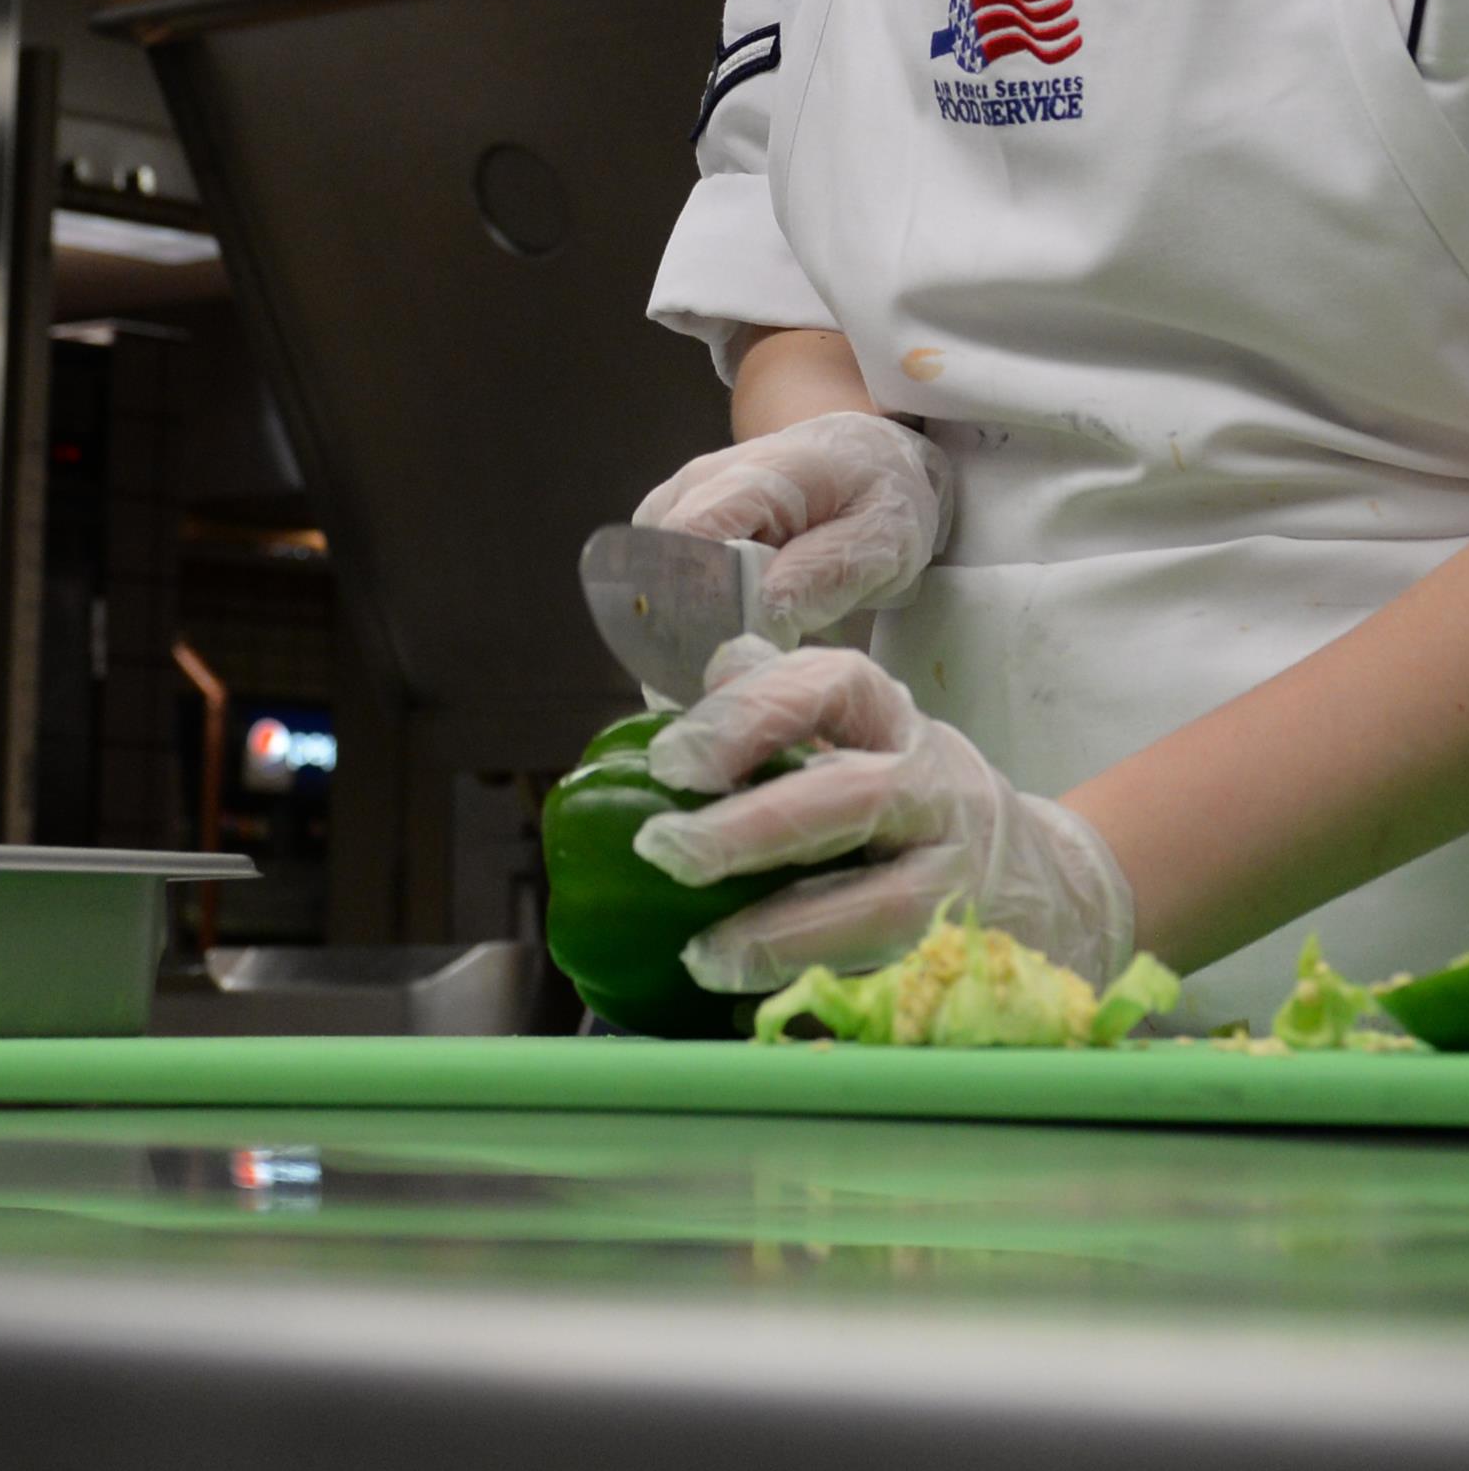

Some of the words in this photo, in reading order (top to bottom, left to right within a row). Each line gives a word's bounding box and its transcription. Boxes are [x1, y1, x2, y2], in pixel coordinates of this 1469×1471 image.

[955, 80, 989, 99] FORCE
[994, 76, 1084, 99] SERVICES
[936, 93, 1084, 126] FOODSERVICE
